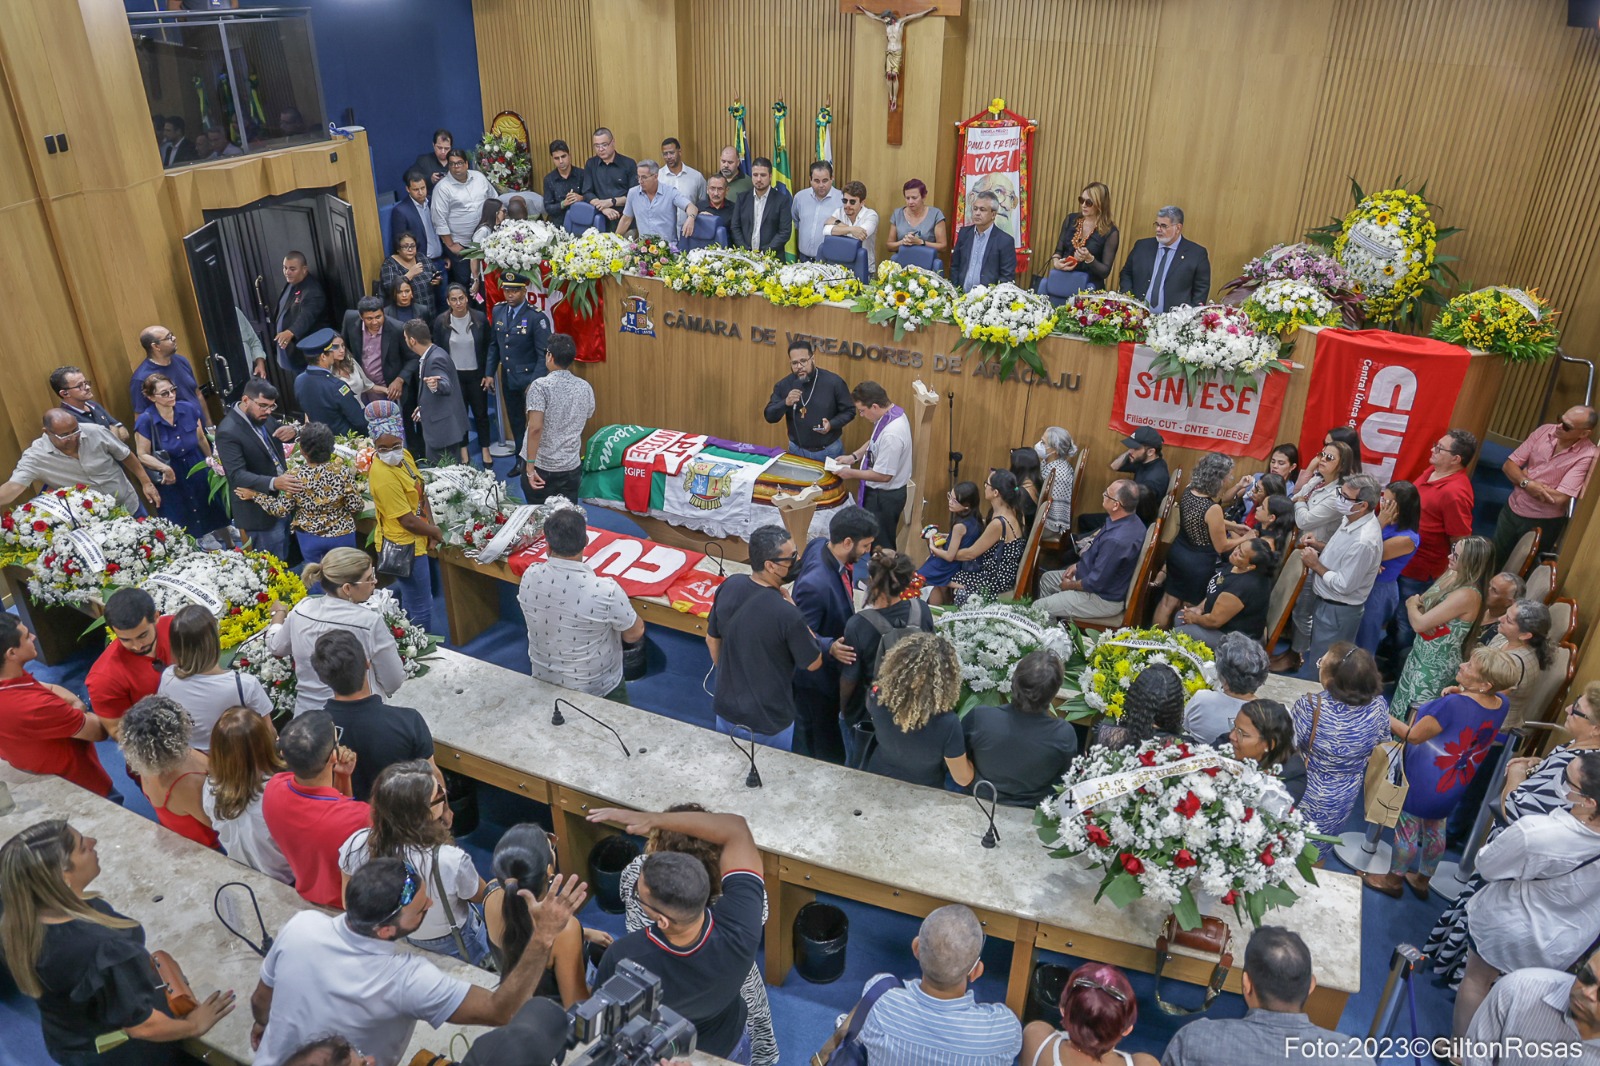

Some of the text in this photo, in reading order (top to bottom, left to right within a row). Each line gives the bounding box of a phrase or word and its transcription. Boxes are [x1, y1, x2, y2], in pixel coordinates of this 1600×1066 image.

[968, 140, 991, 151] PAULO
[975, 151, 1012, 172] VIVE!
[528, 292, 548, 311] PT
[663, 308, 742, 340] CÂMARA
[751, 326, 776, 345] DE
[933, 354, 962, 375] DE
[1357, 359, 1372, 392] Central
[1134, 371, 1256, 415] SINESE
[1351, 392, 1365, 418] Única
[1126, 414, 1156, 427] Filiado:
[1158, 420, 1178, 430] CUT
[1184, 424, 1209, 435] CNTE
[1216, 429, 1249, 442] DIEESE
[663, 438, 698, 458] PT
